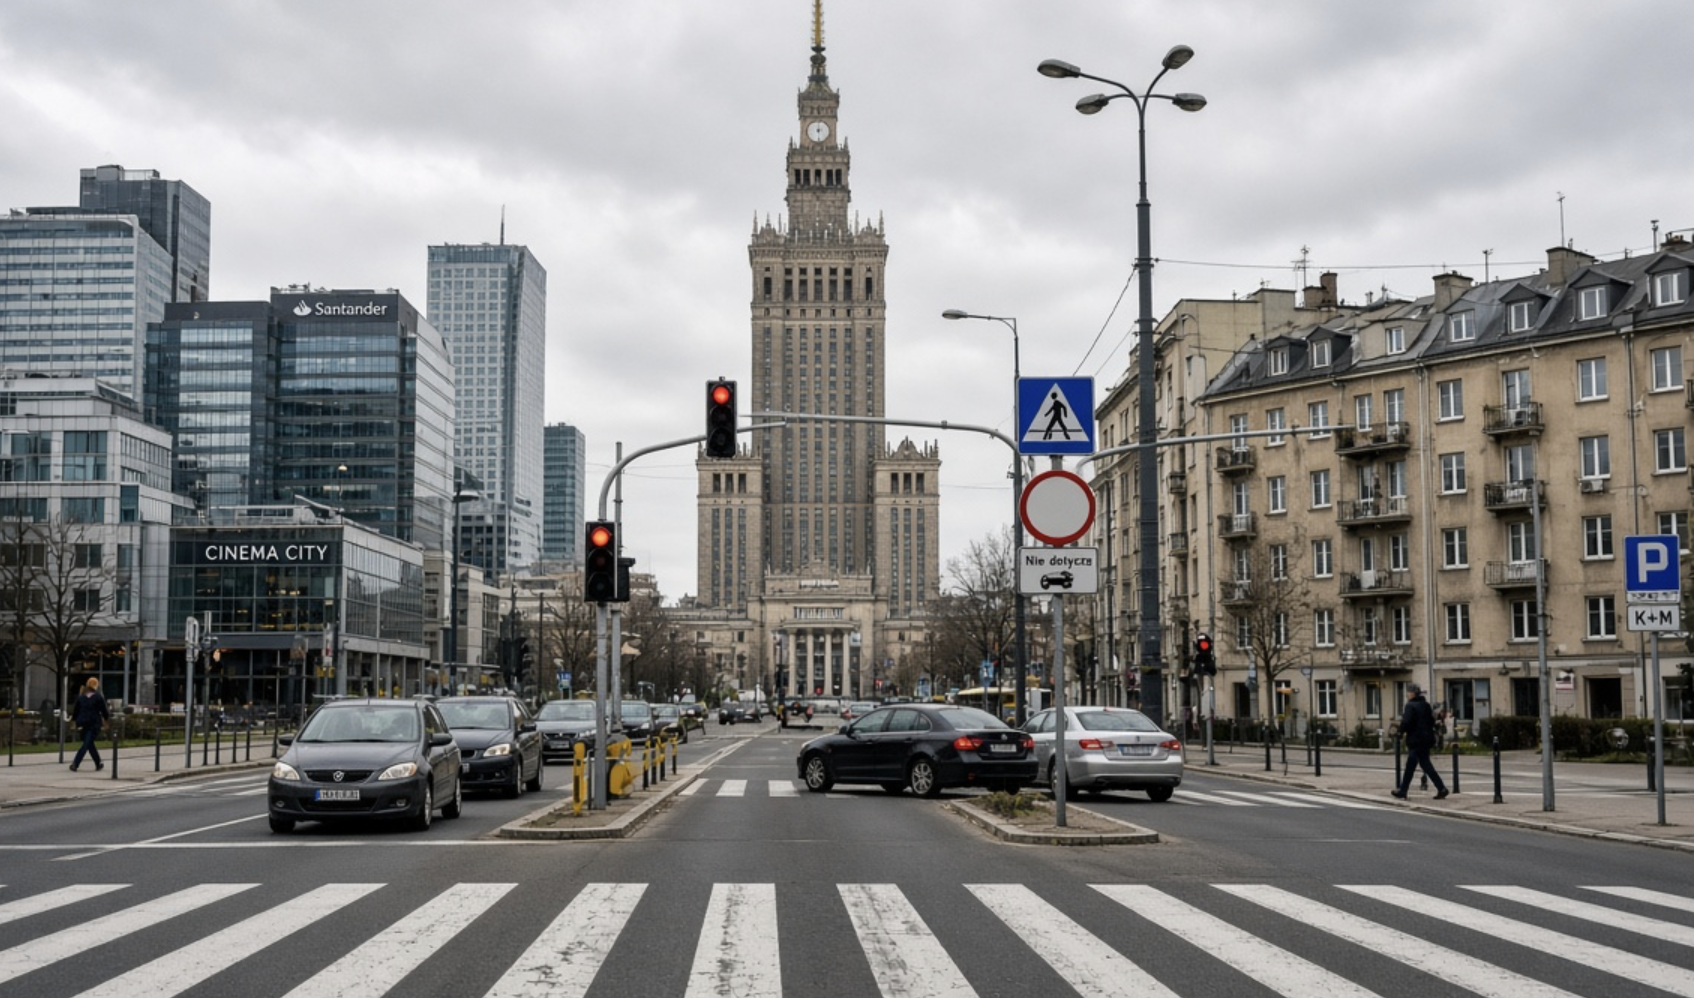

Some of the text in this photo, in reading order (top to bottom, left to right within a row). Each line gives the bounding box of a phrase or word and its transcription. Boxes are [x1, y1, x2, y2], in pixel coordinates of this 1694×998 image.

[315, 301, 388, 316] Santander
[205, 545, 328, 561] CINEMA CITY
[1026, 555, 1045, 567] Nie
[1637, 542, 1669, 583] P
[1635, 610, 1673, 626] K+M
